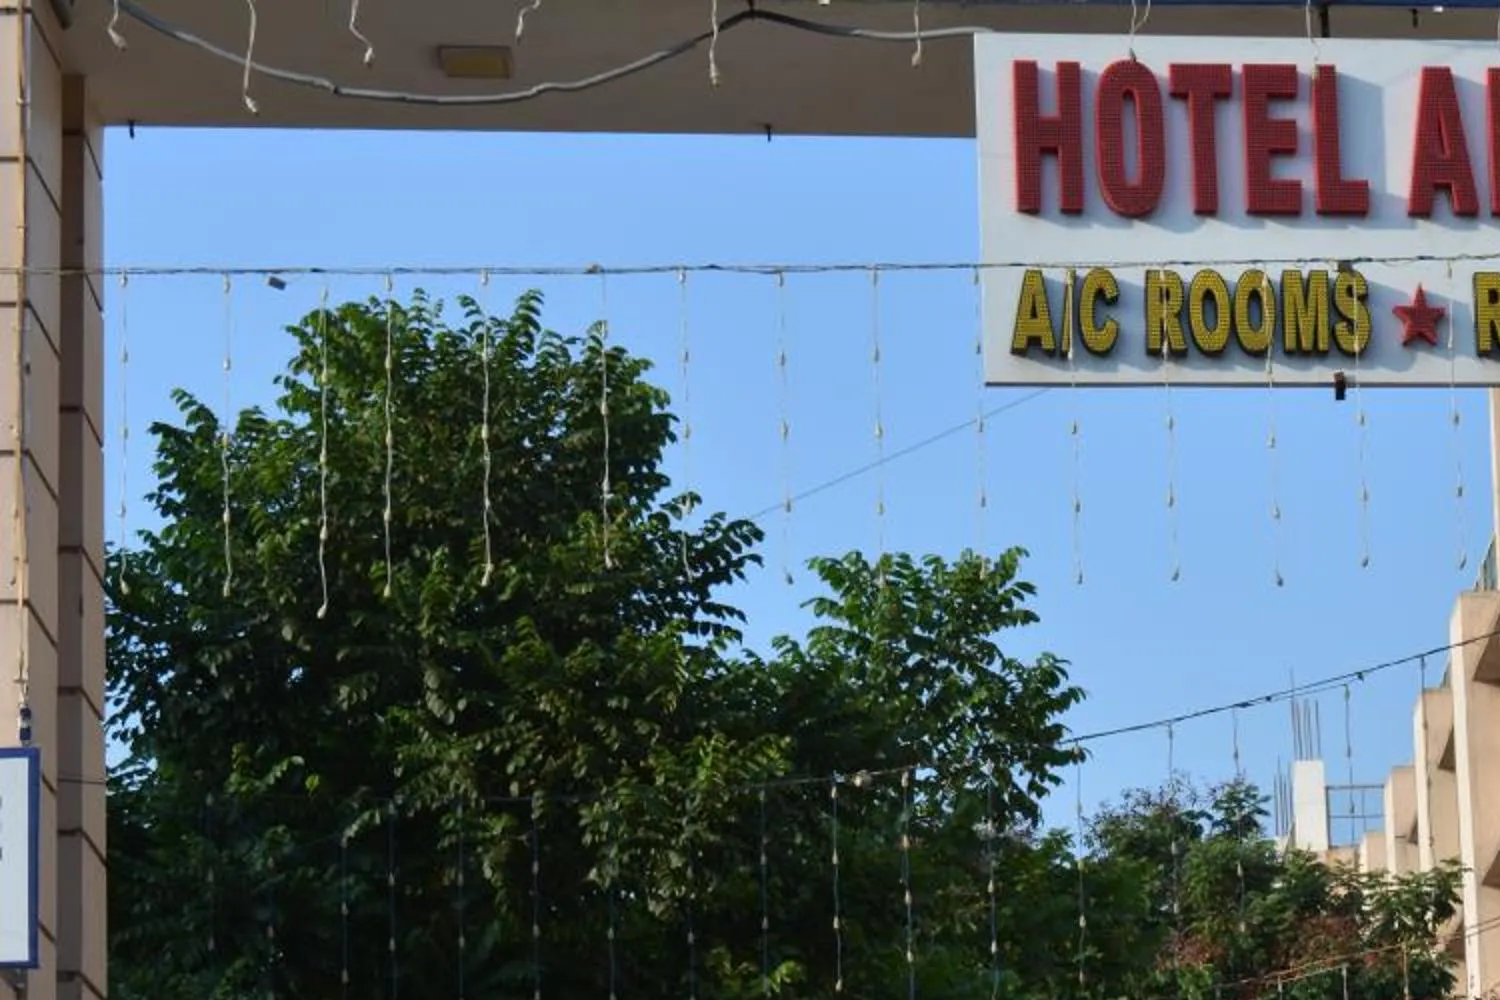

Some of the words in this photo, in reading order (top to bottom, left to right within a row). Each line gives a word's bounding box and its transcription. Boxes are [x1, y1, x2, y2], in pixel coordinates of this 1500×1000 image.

[1012, 59, 1369, 218] HOTEL
[1010, 268, 1120, 357] A/C
[1144, 268, 1372, 358] ROOMS
